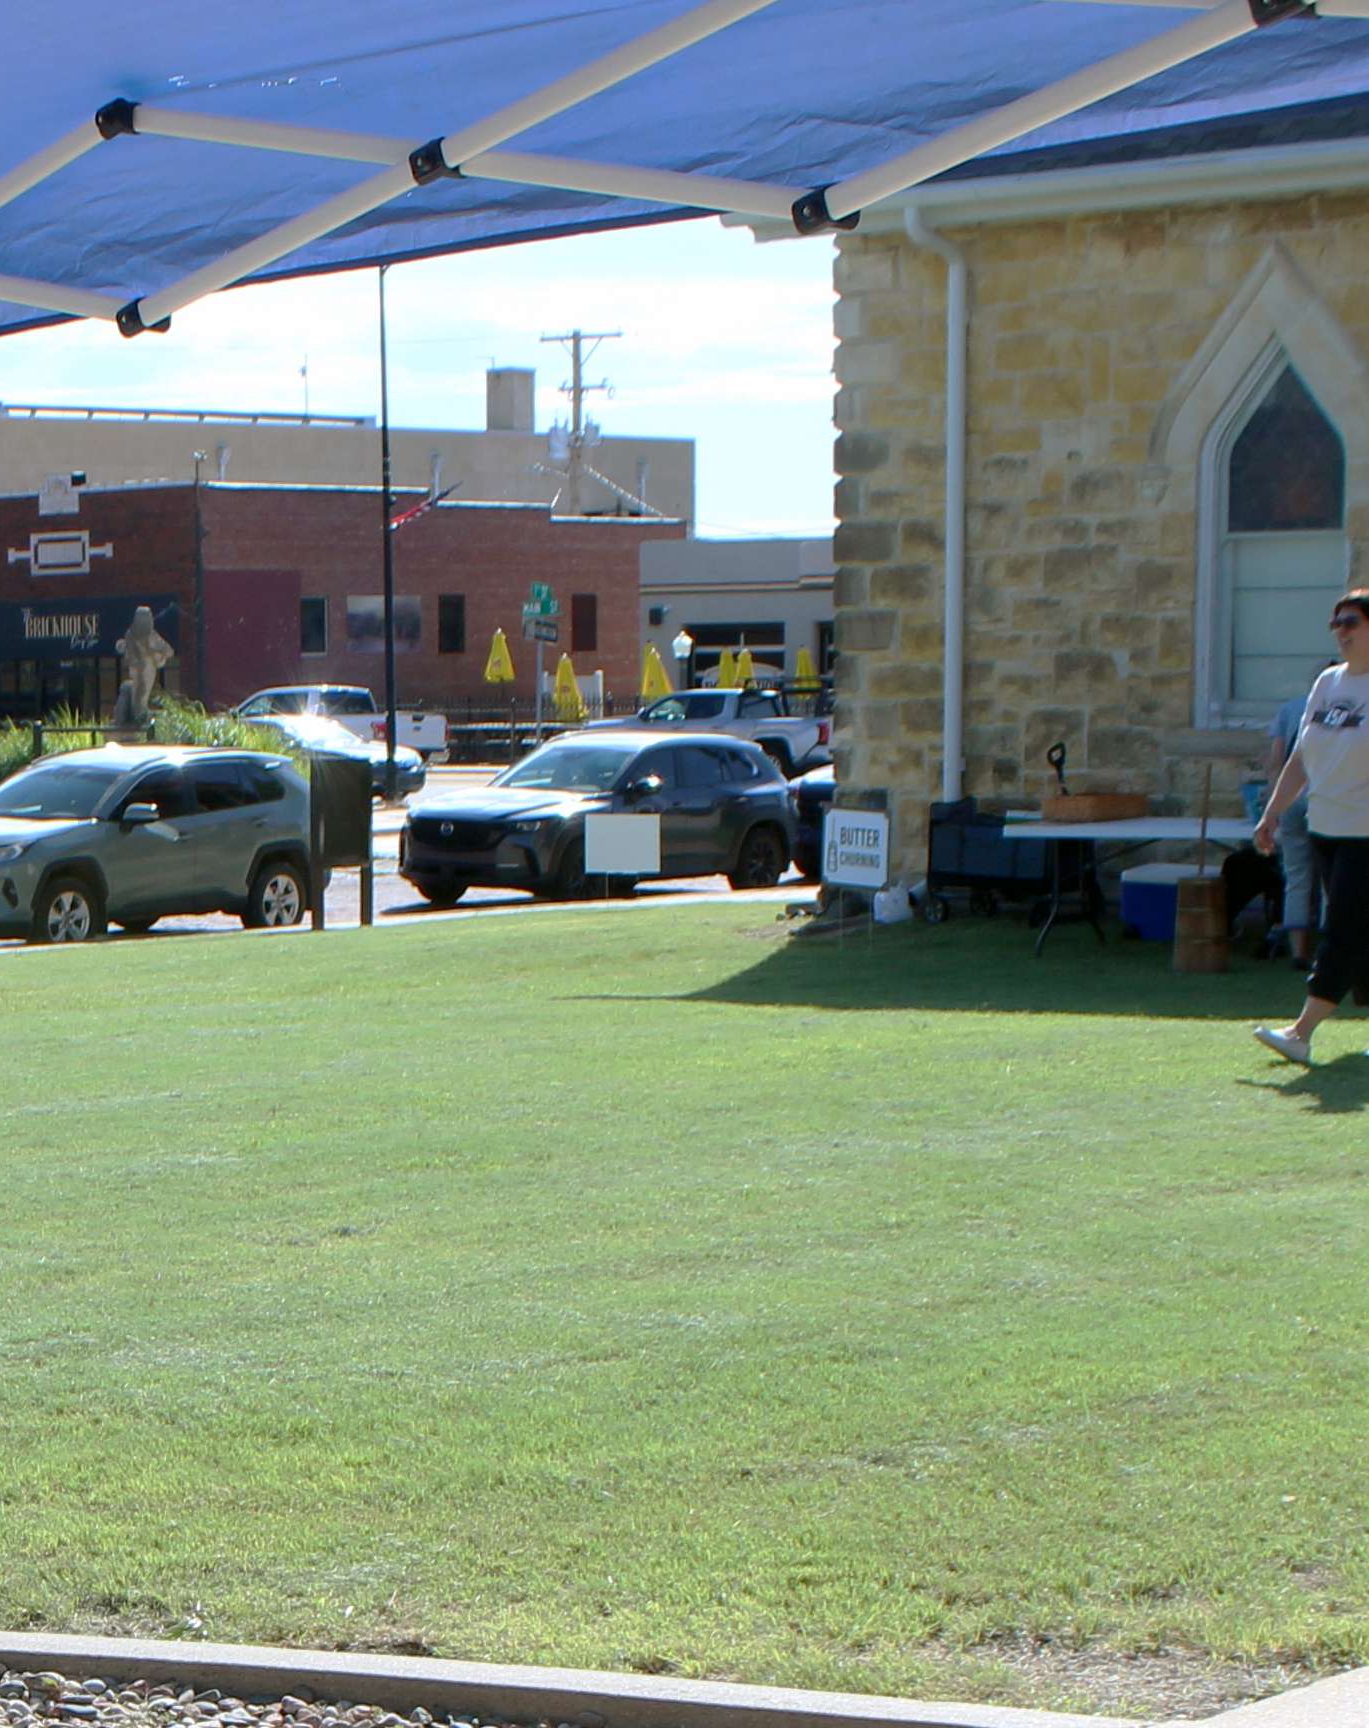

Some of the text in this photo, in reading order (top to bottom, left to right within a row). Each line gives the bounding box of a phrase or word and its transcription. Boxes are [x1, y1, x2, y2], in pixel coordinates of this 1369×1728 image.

[25, 613, 100, 639] BRICKHOUSE
[839, 825, 880, 849] BUTTER
[839, 851, 881, 870] CHURNING
